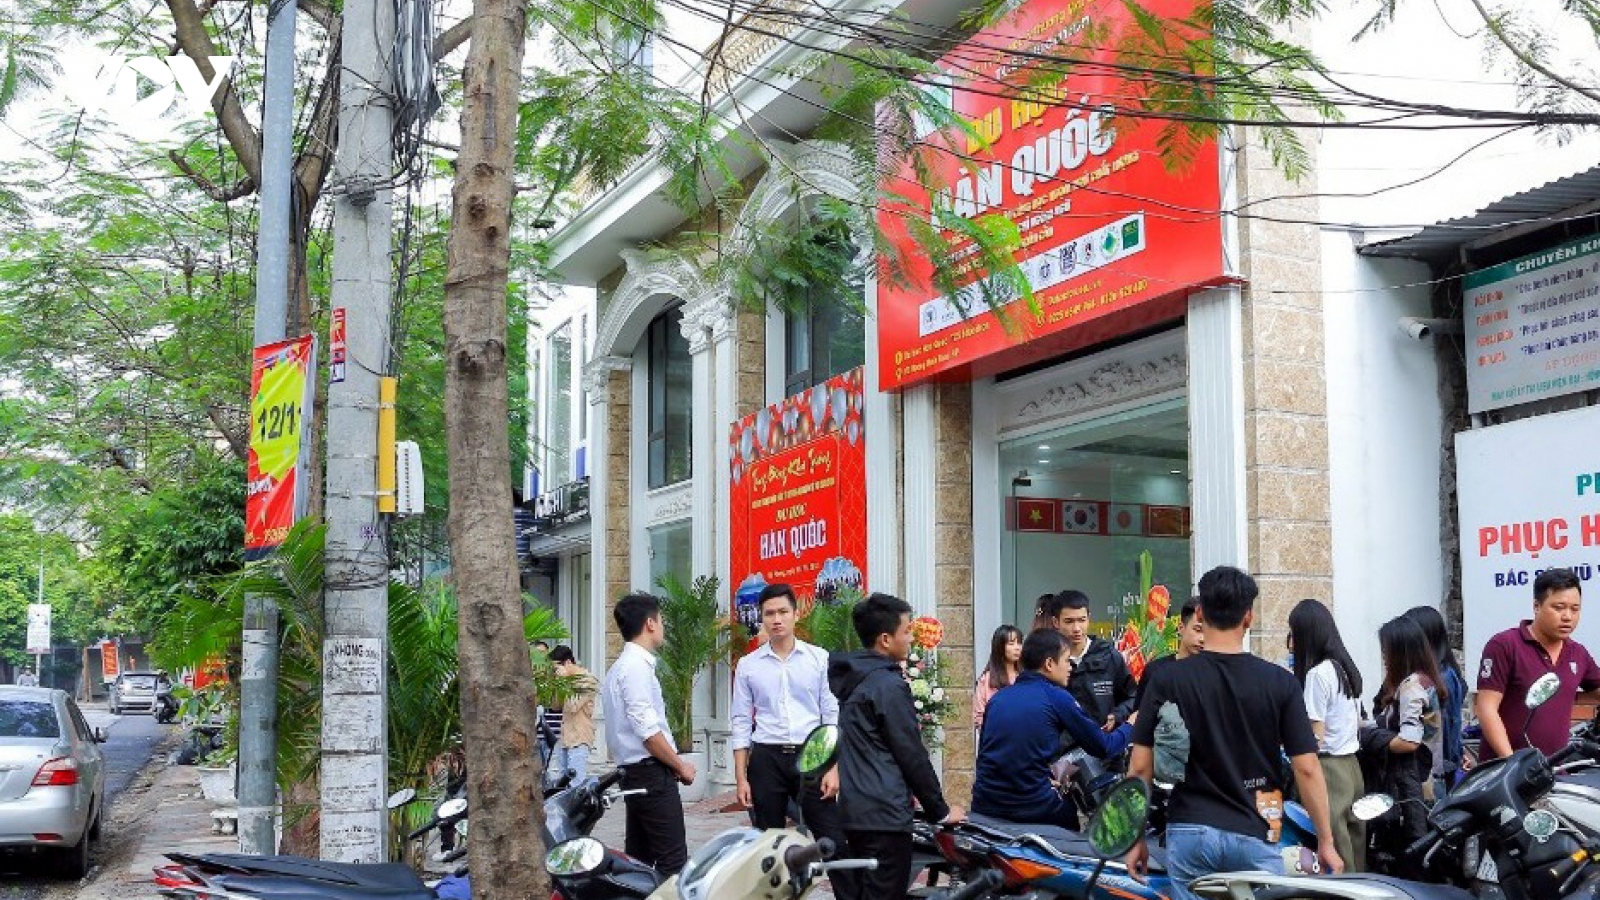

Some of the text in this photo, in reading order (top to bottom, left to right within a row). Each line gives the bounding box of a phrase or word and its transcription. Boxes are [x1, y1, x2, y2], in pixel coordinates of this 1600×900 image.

[966, 107, 1003, 156] DU
[1011, 95, 1118, 197] QUỐC
[1515, 246, 1577, 272] CHUYÊN
[258, 400, 302, 442] 12/1
[760, 514, 827, 560] HÀN QUỐC
[1478, 518, 1568, 559] PHỤC
[1494, 567, 1529, 588] BÁC
[1480, 658, 1493, 679] 3
